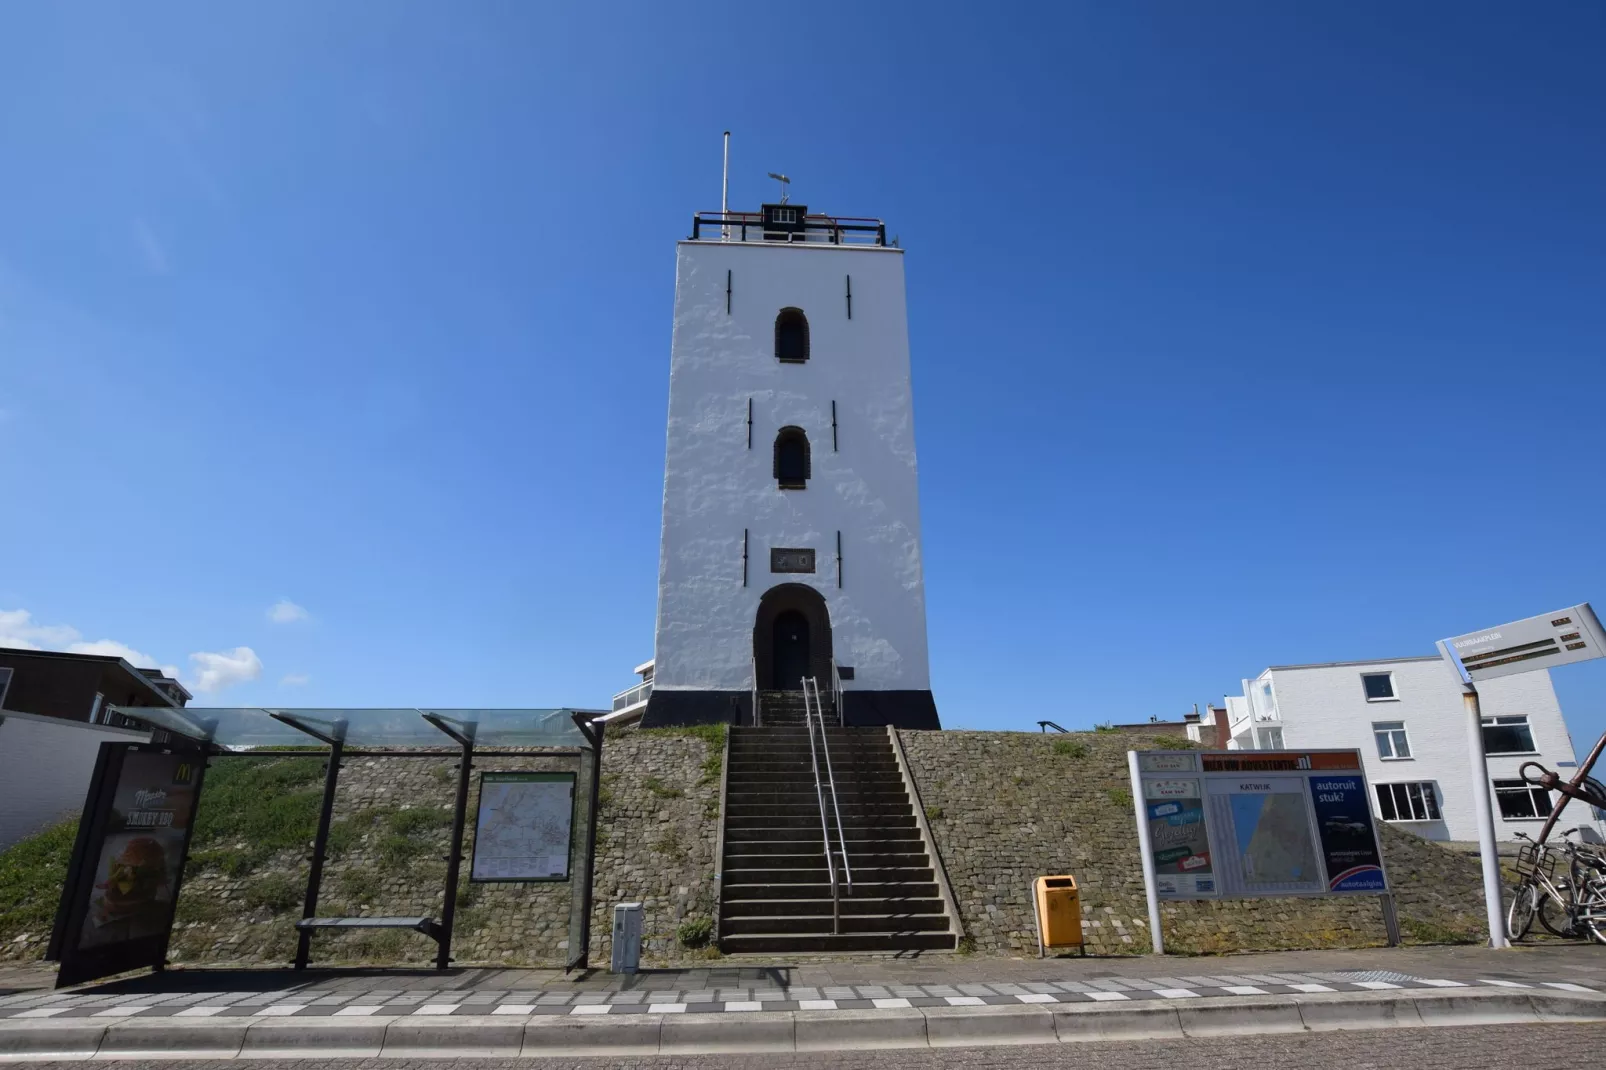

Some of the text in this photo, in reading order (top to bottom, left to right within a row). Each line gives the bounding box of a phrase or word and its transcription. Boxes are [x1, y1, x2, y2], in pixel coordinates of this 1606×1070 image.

[1239, 783, 1272, 791] KATWIJK
[1316, 780, 1356, 791] autoruit
[1319, 792, 1344, 803] stuk?
[126, 811, 159, 826] SMOKEY
[1340, 880, 1383, 890] autotaalglas
